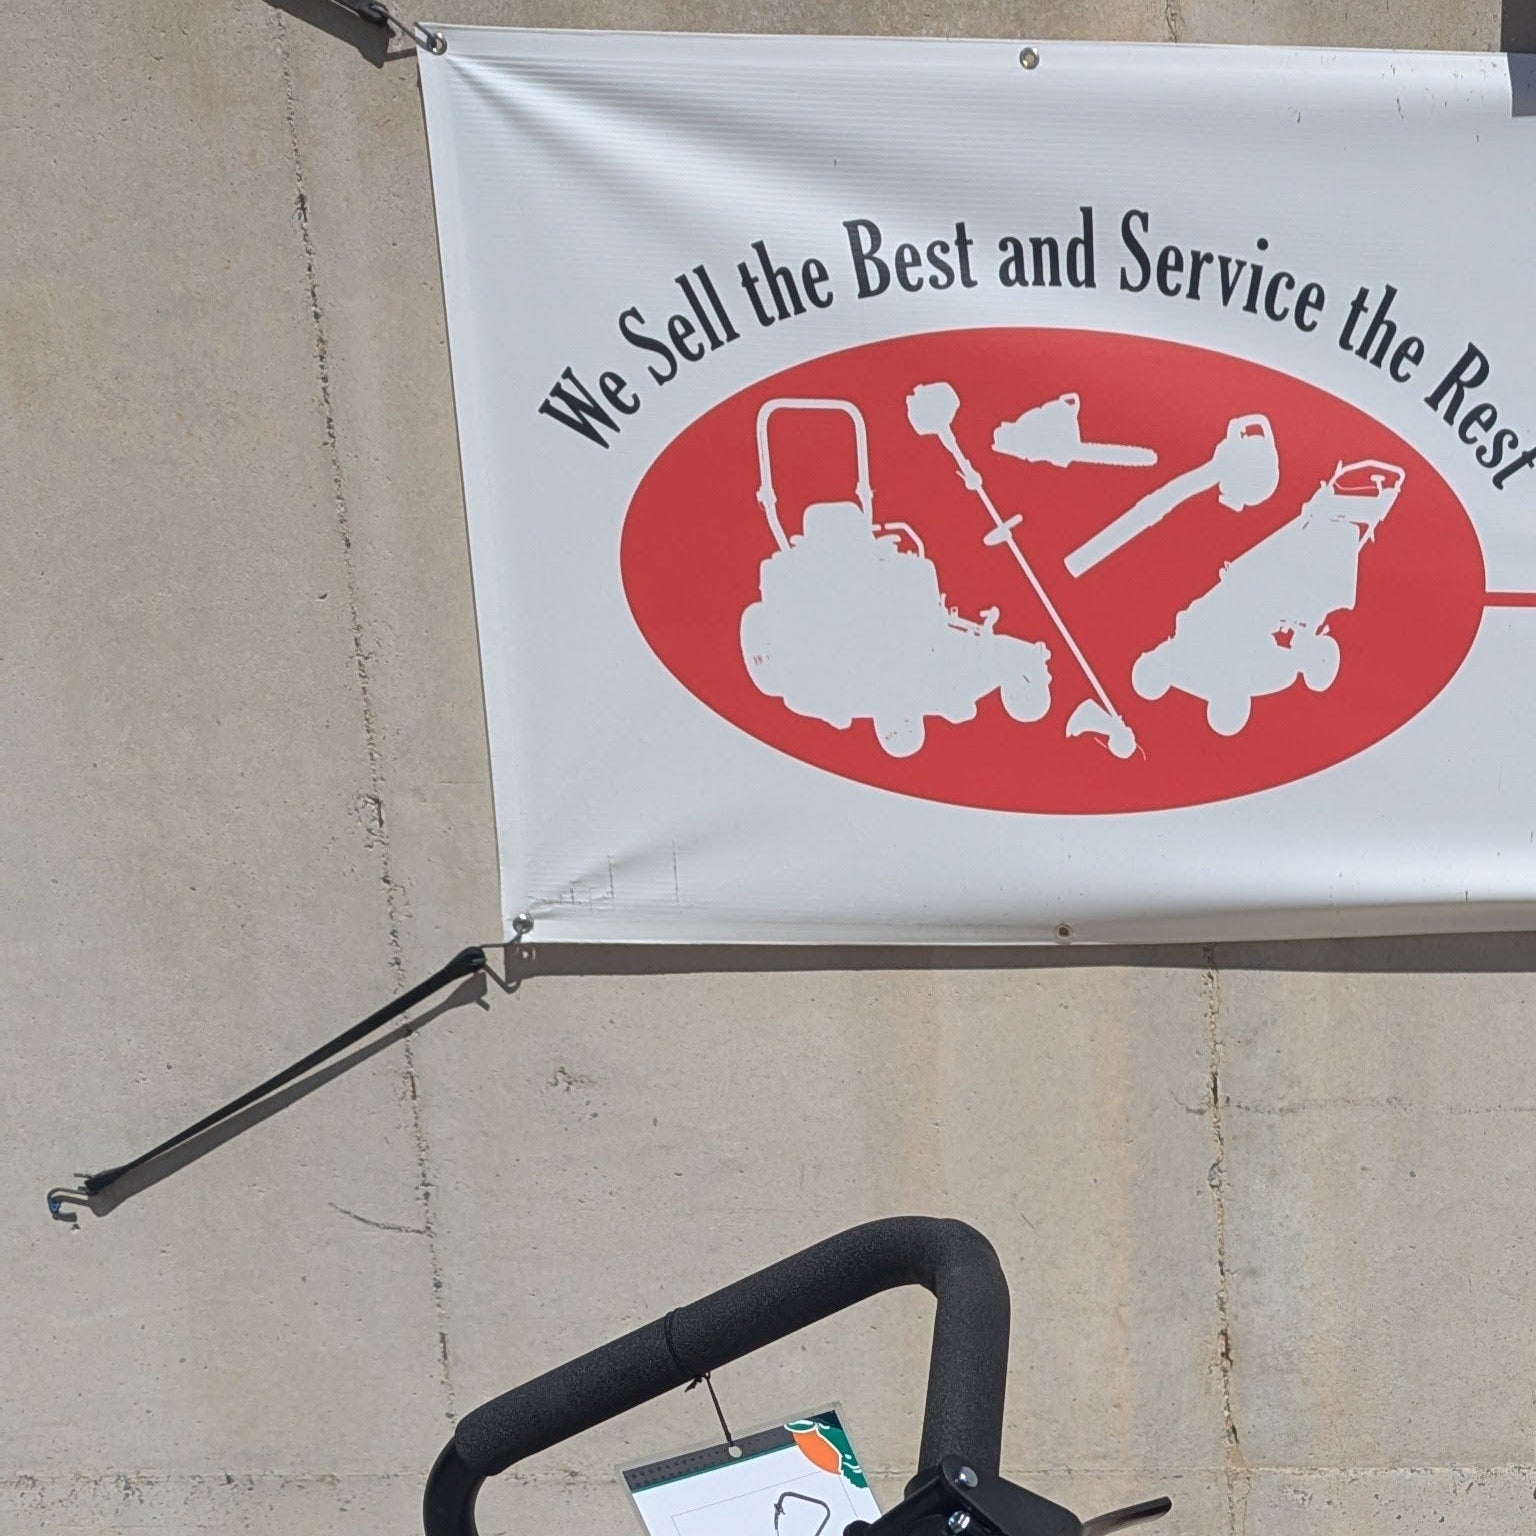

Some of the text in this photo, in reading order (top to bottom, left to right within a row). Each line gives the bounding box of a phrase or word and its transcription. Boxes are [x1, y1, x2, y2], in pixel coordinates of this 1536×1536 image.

[538, 366, 641, 449] We
[618, 264, 741, 386] Sell
[737, 240, 834, 327] the
[843, 219, 978, 299] Best
[998, 206, 1097, 288] and
[1119, 209, 1325, 332] Service
[1338, 284, 1425, 383] the
